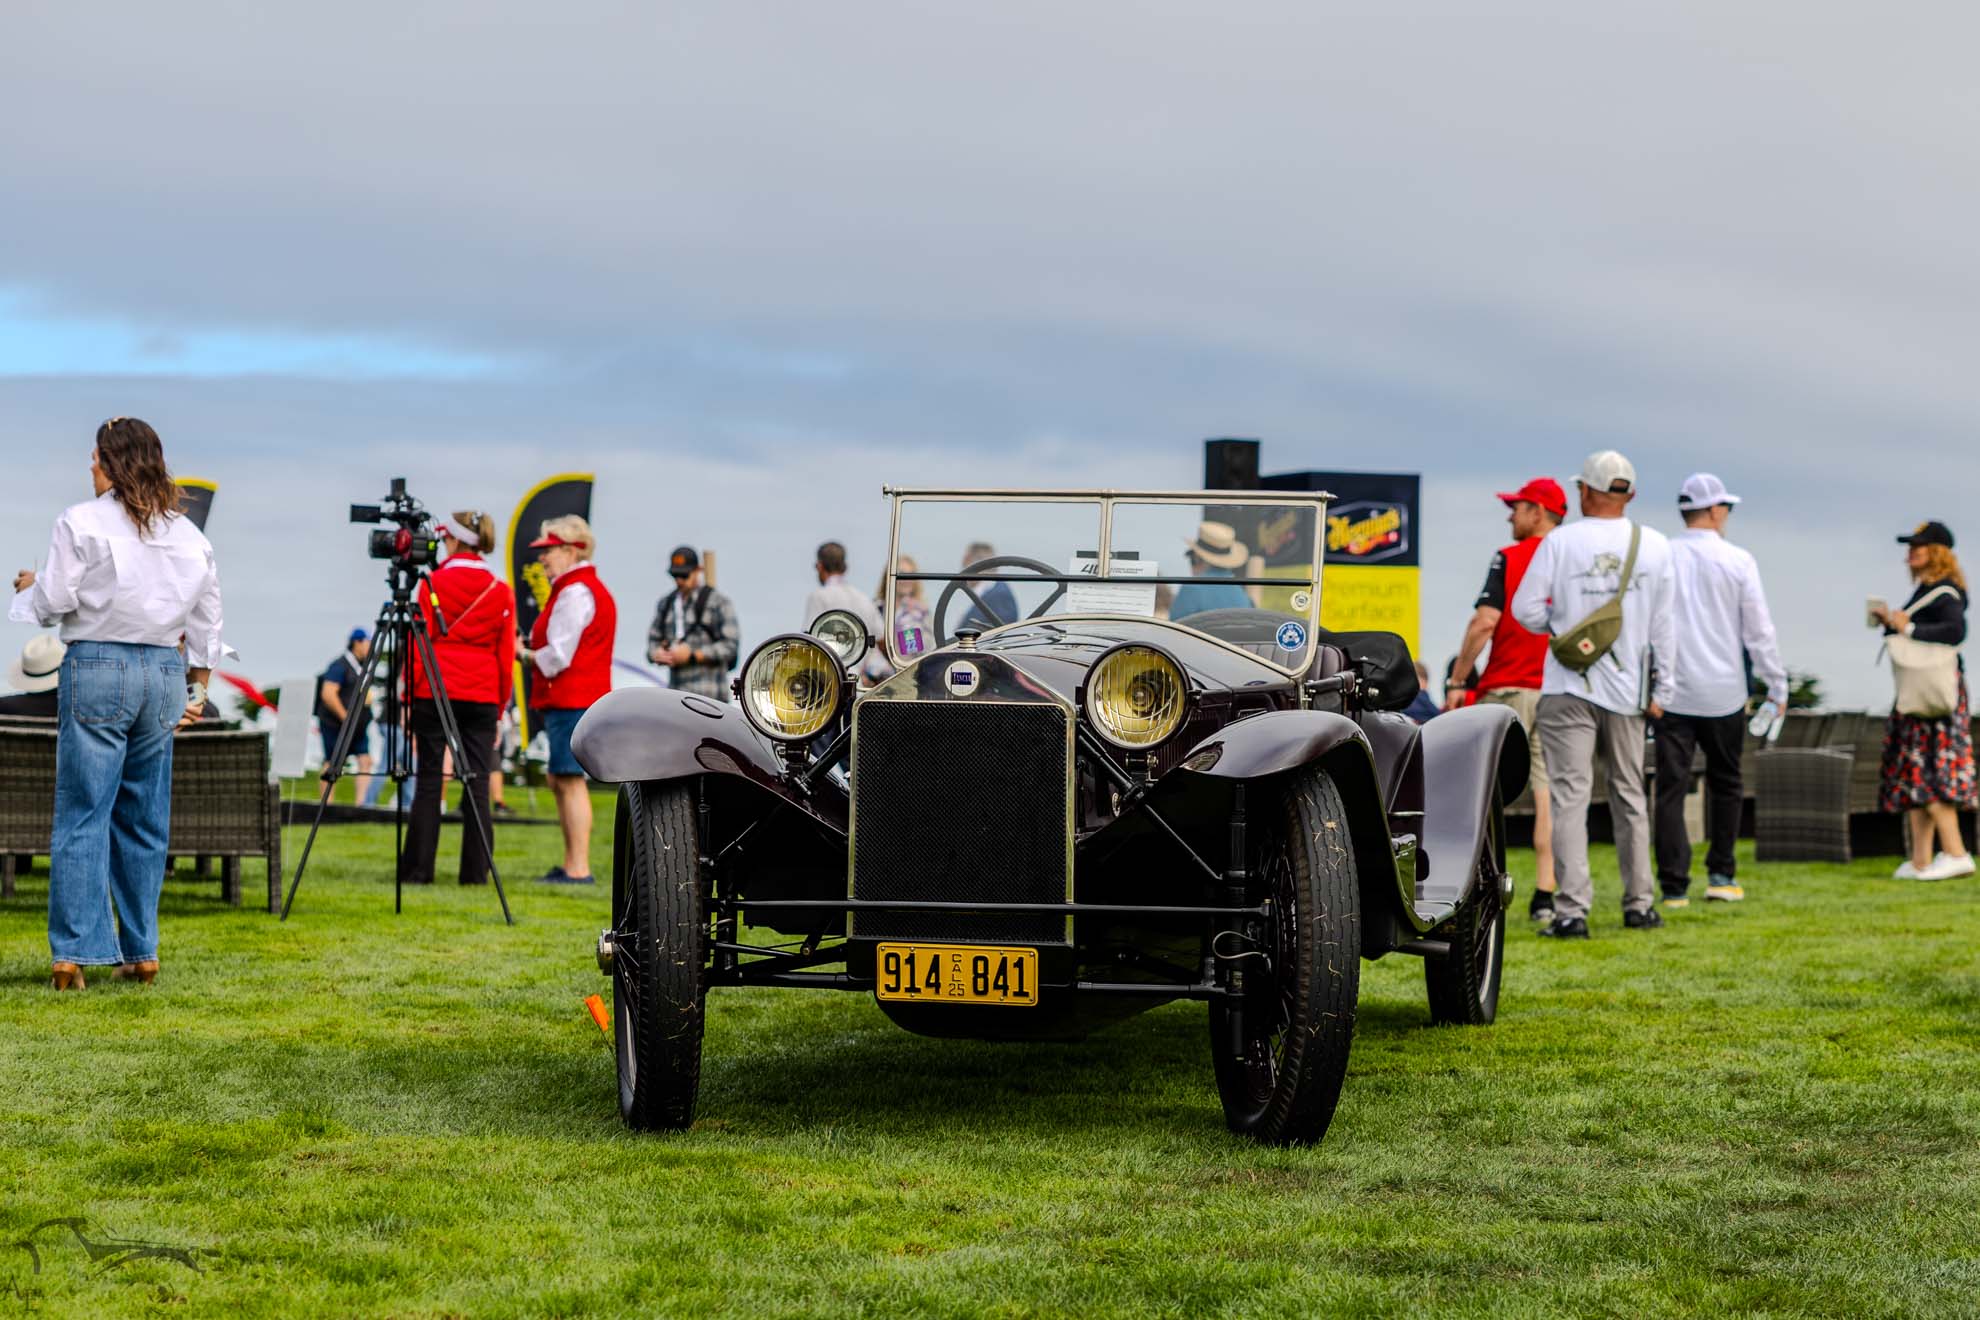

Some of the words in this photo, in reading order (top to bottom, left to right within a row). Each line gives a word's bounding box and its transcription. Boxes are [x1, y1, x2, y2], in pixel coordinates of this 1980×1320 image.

[884, 952, 942, 995] 914
[951, 953, 962, 982] CAL
[972, 955, 1030, 997] 841
[948, 983, 965, 996] 25
